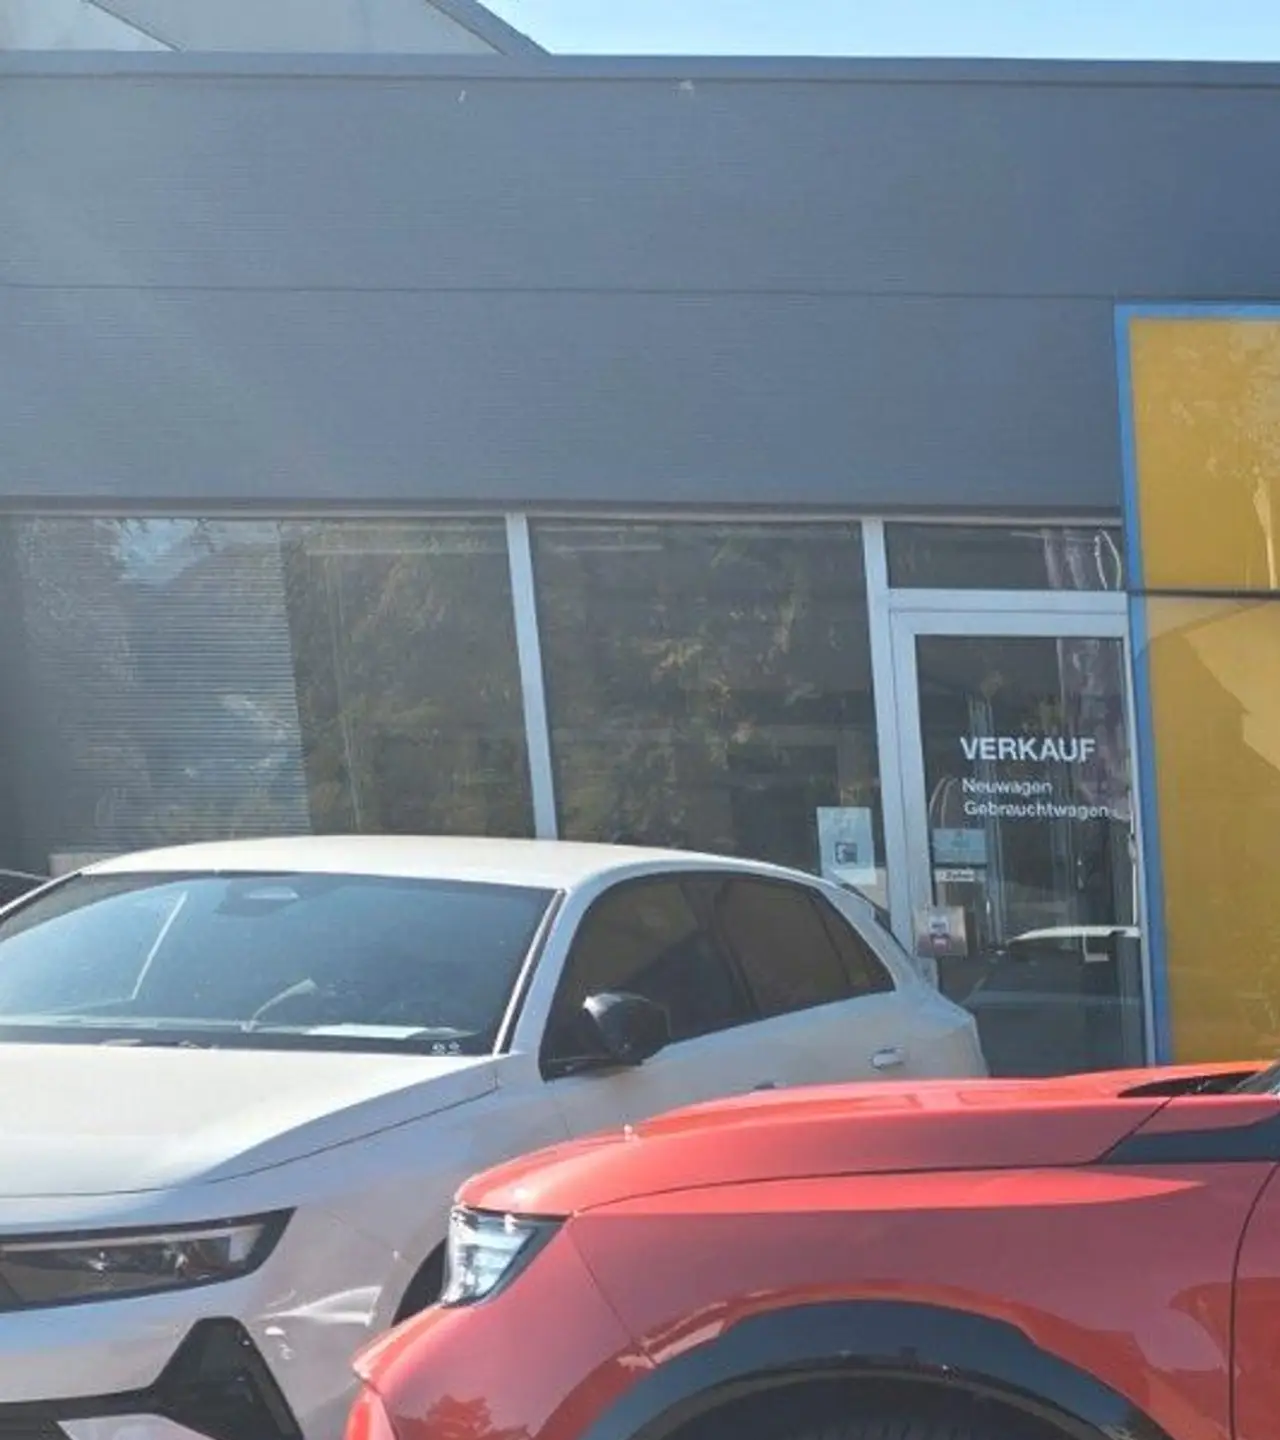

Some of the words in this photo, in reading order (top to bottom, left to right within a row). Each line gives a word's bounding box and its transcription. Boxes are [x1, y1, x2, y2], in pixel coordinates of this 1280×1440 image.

[960, 736, 1096, 762] VERKAUF
[962, 778, 1053, 796] Neuwagen
[963, 800, 1110, 821] Gebrauchtwagen
